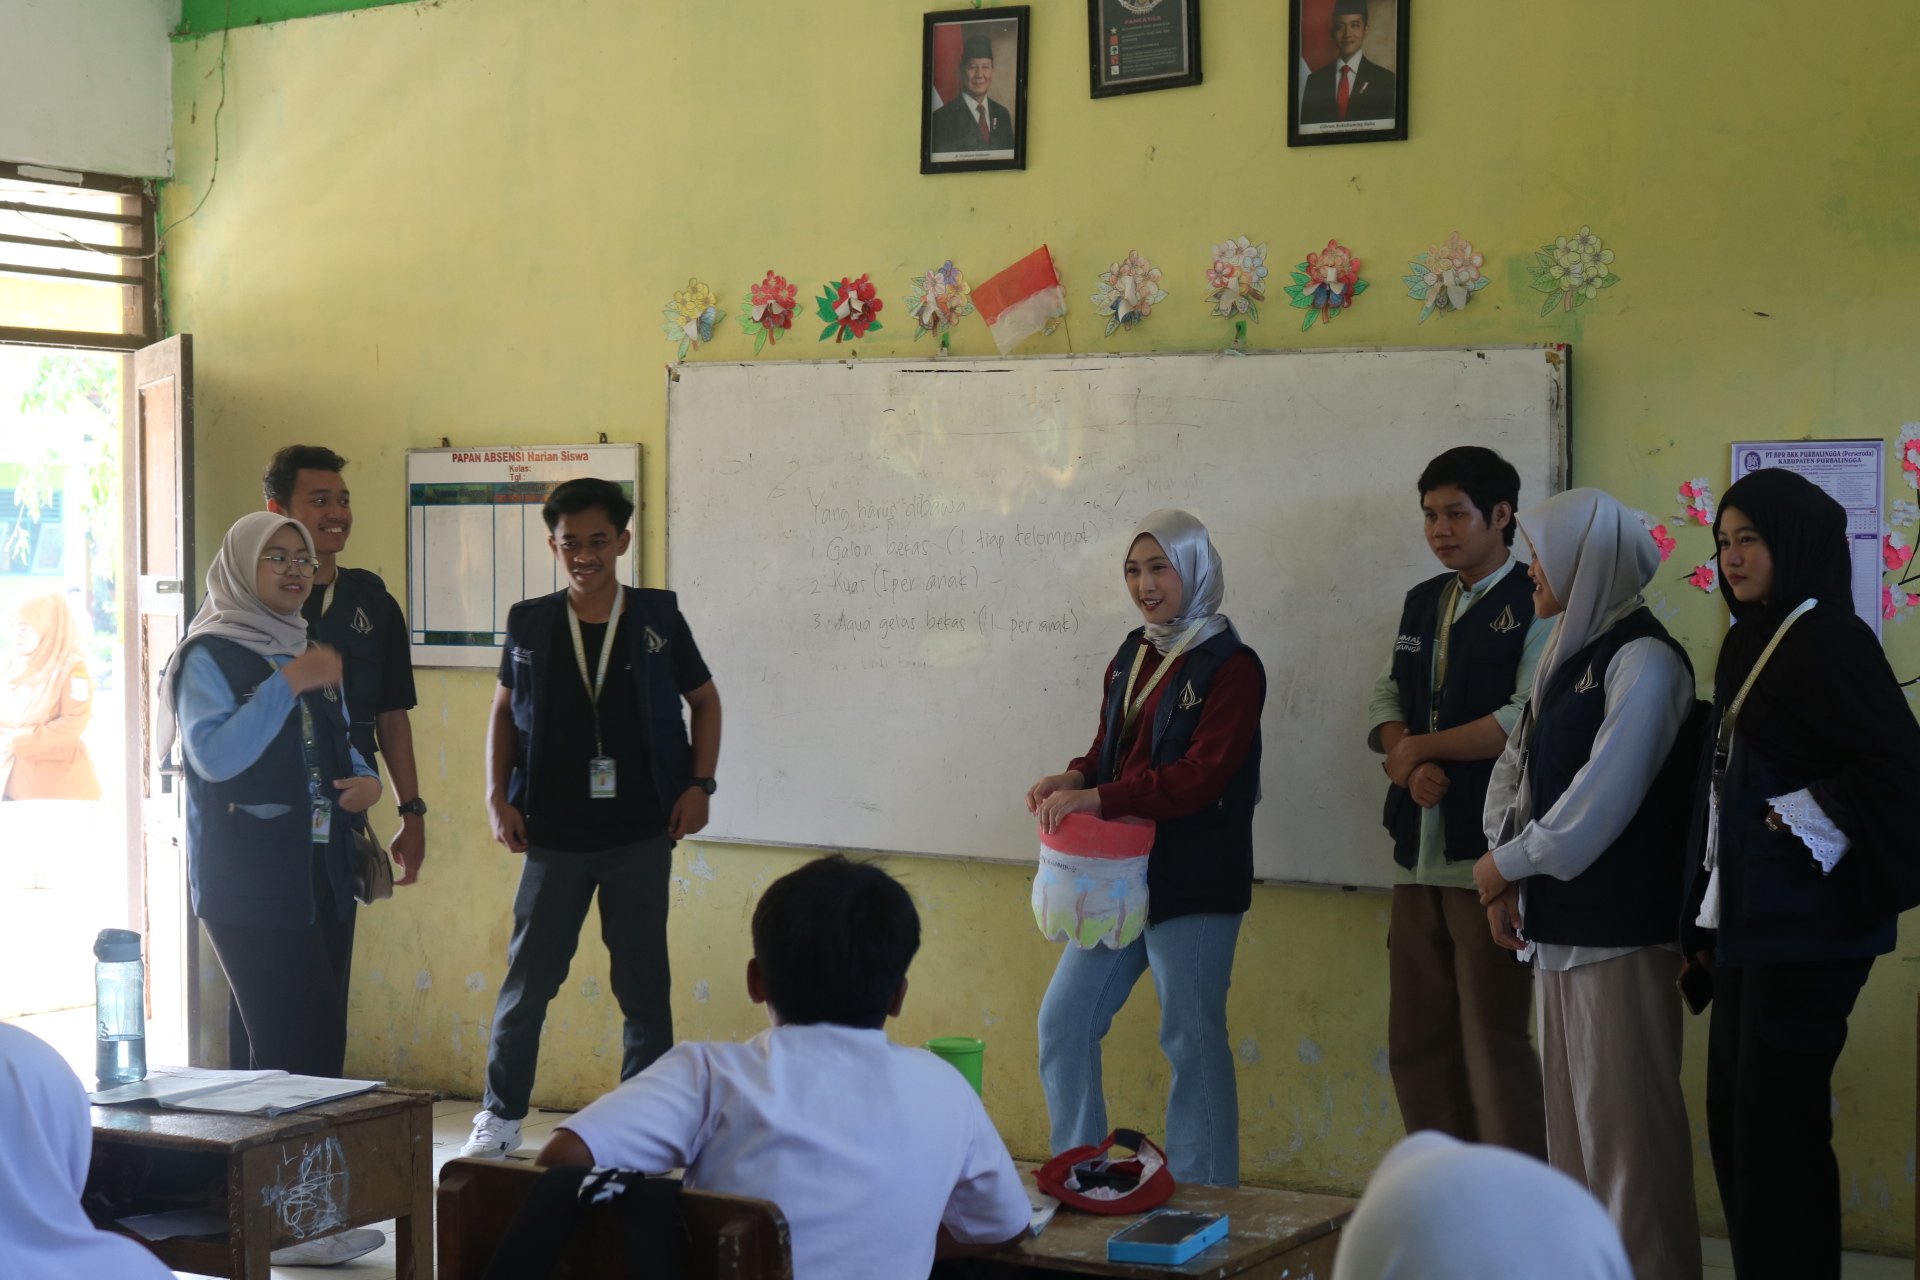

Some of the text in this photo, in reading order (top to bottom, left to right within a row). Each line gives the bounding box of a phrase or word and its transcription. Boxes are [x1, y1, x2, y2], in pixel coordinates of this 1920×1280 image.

[452, 450, 589, 463] PAPAN ABSENSI Harian Siswa
[1765, 451, 1773, 459] PT
[1773, 451, 1786, 459] BPR
[1800, 450, 1841, 458] PURBALINGGA
[807, 486, 850, 532] Yang
[905, 494, 966, 518] dibawa
[826, 536, 873, 562] Galon
[832, 568, 865, 594] Kuas
[834, 607, 871, 641] Aqua
[879, 614, 916, 640] gelas
[1010, 617, 1033, 642] per
